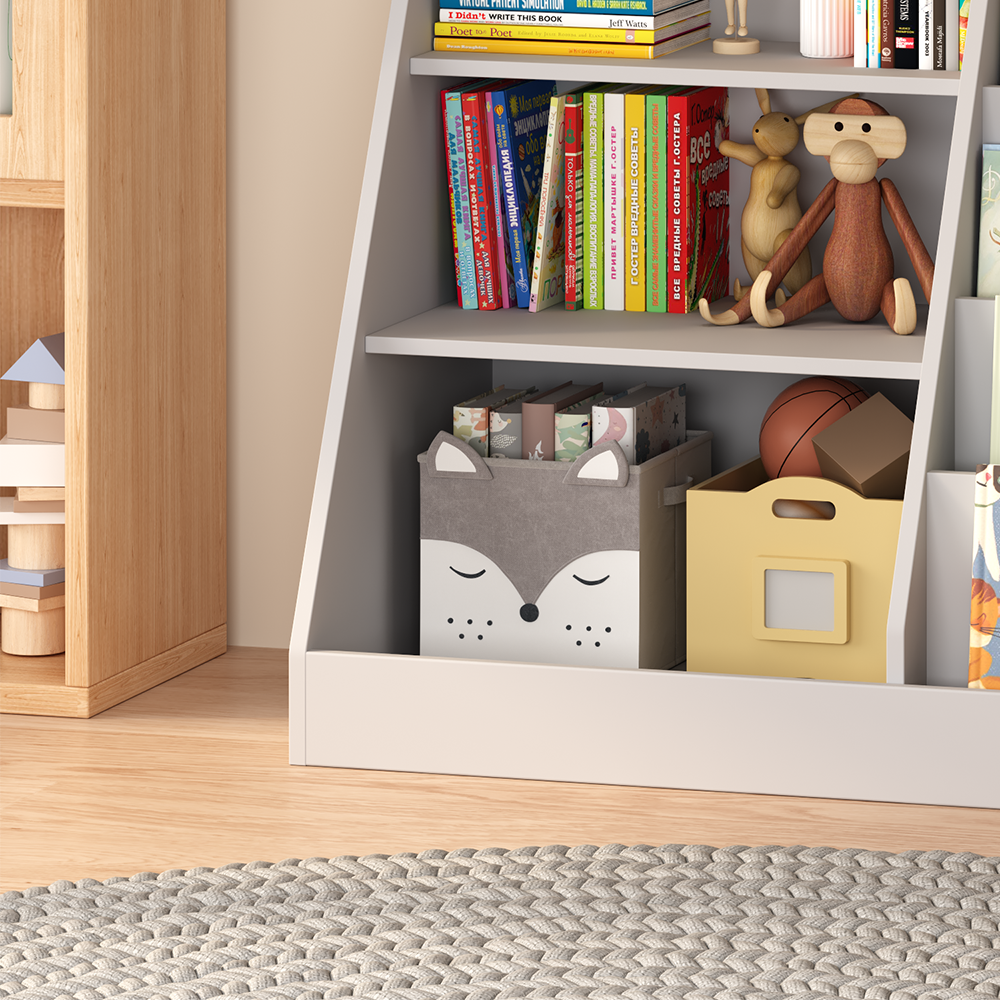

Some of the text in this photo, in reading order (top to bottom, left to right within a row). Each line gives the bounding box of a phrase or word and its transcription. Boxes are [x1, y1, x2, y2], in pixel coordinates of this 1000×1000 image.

[450, 26, 512, 37] Poet Poet
[608, 19, 647, 28] Jeff Watts
[589, 95, 597, 127] ВРЕДНЫЕ
[631, 127, 639, 177] СОВЕТЫ
[652, 136, 660, 172] ВРЕДНЫЕ
[673, 113, 681, 165] Г.ОСТЕРА
[451, 160, 463, 224] МАЛЬЧИКОВ
[455, 115, 471, 241] САМАЯ ЛУЧШАЯ КНИГА
[465, 125, 476, 179] ВОПРОСАХ
[471, 197, 481, 243] ОТВЕТАХ
[471, 116, 488, 242] САМАЯ ЛУЧШАЯ КНИГА
[501, 149, 519, 227] ЭНЦИКЛОПЕДИЯ
[565, 195, 573, 209] для
[631, 179, 640, 236] ВРЕДНЫЕ
[513, 229, 521, 249] первая
[589, 224, 597, 268] ВОСПИТАНИЕ
[674, 218, 682, 271] ВРЕДНЫЕ
[476, 259, 486, 296] ДЕВОЧЕК
[589, 270, 597, 307] ВЗРОСЛЫХ
